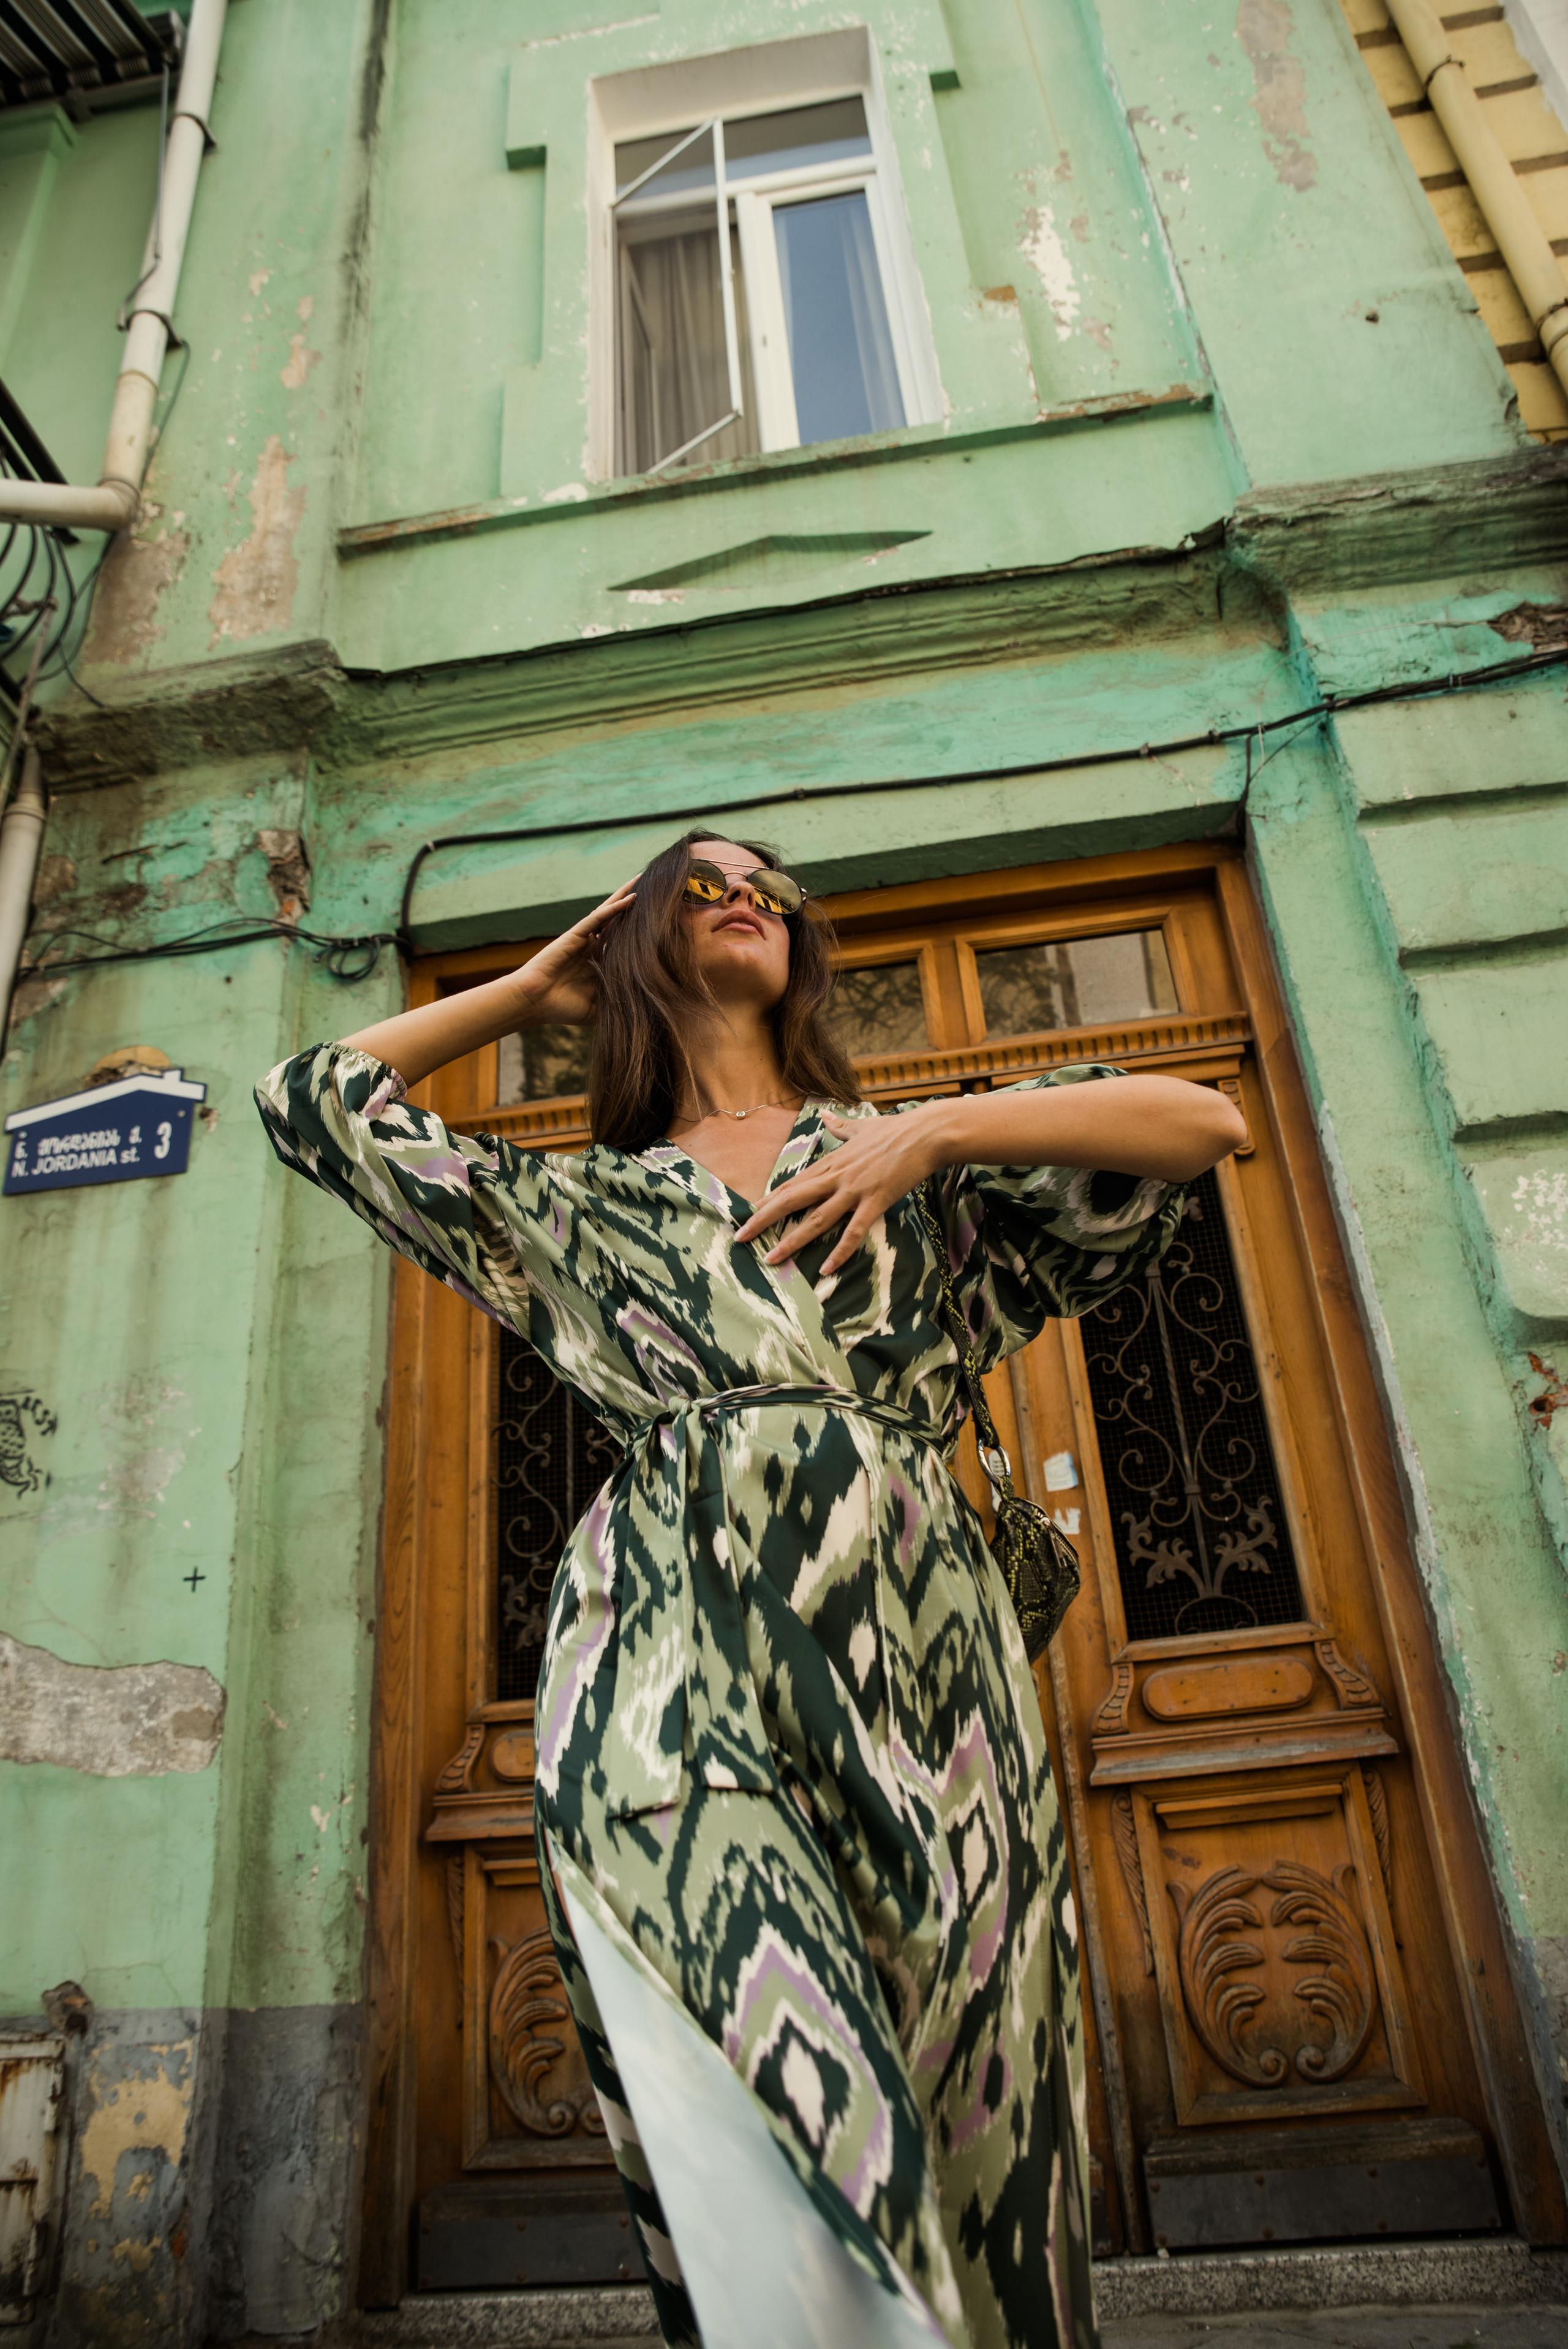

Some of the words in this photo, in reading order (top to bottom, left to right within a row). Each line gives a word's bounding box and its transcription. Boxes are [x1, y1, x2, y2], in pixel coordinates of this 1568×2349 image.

[154, 1121, 172, 1159] 3
[11, 1160, 29, 1178] N.
[31, 1148, 118, 1175] JORDANIA
[120, 1146, 140, 1164] st.
